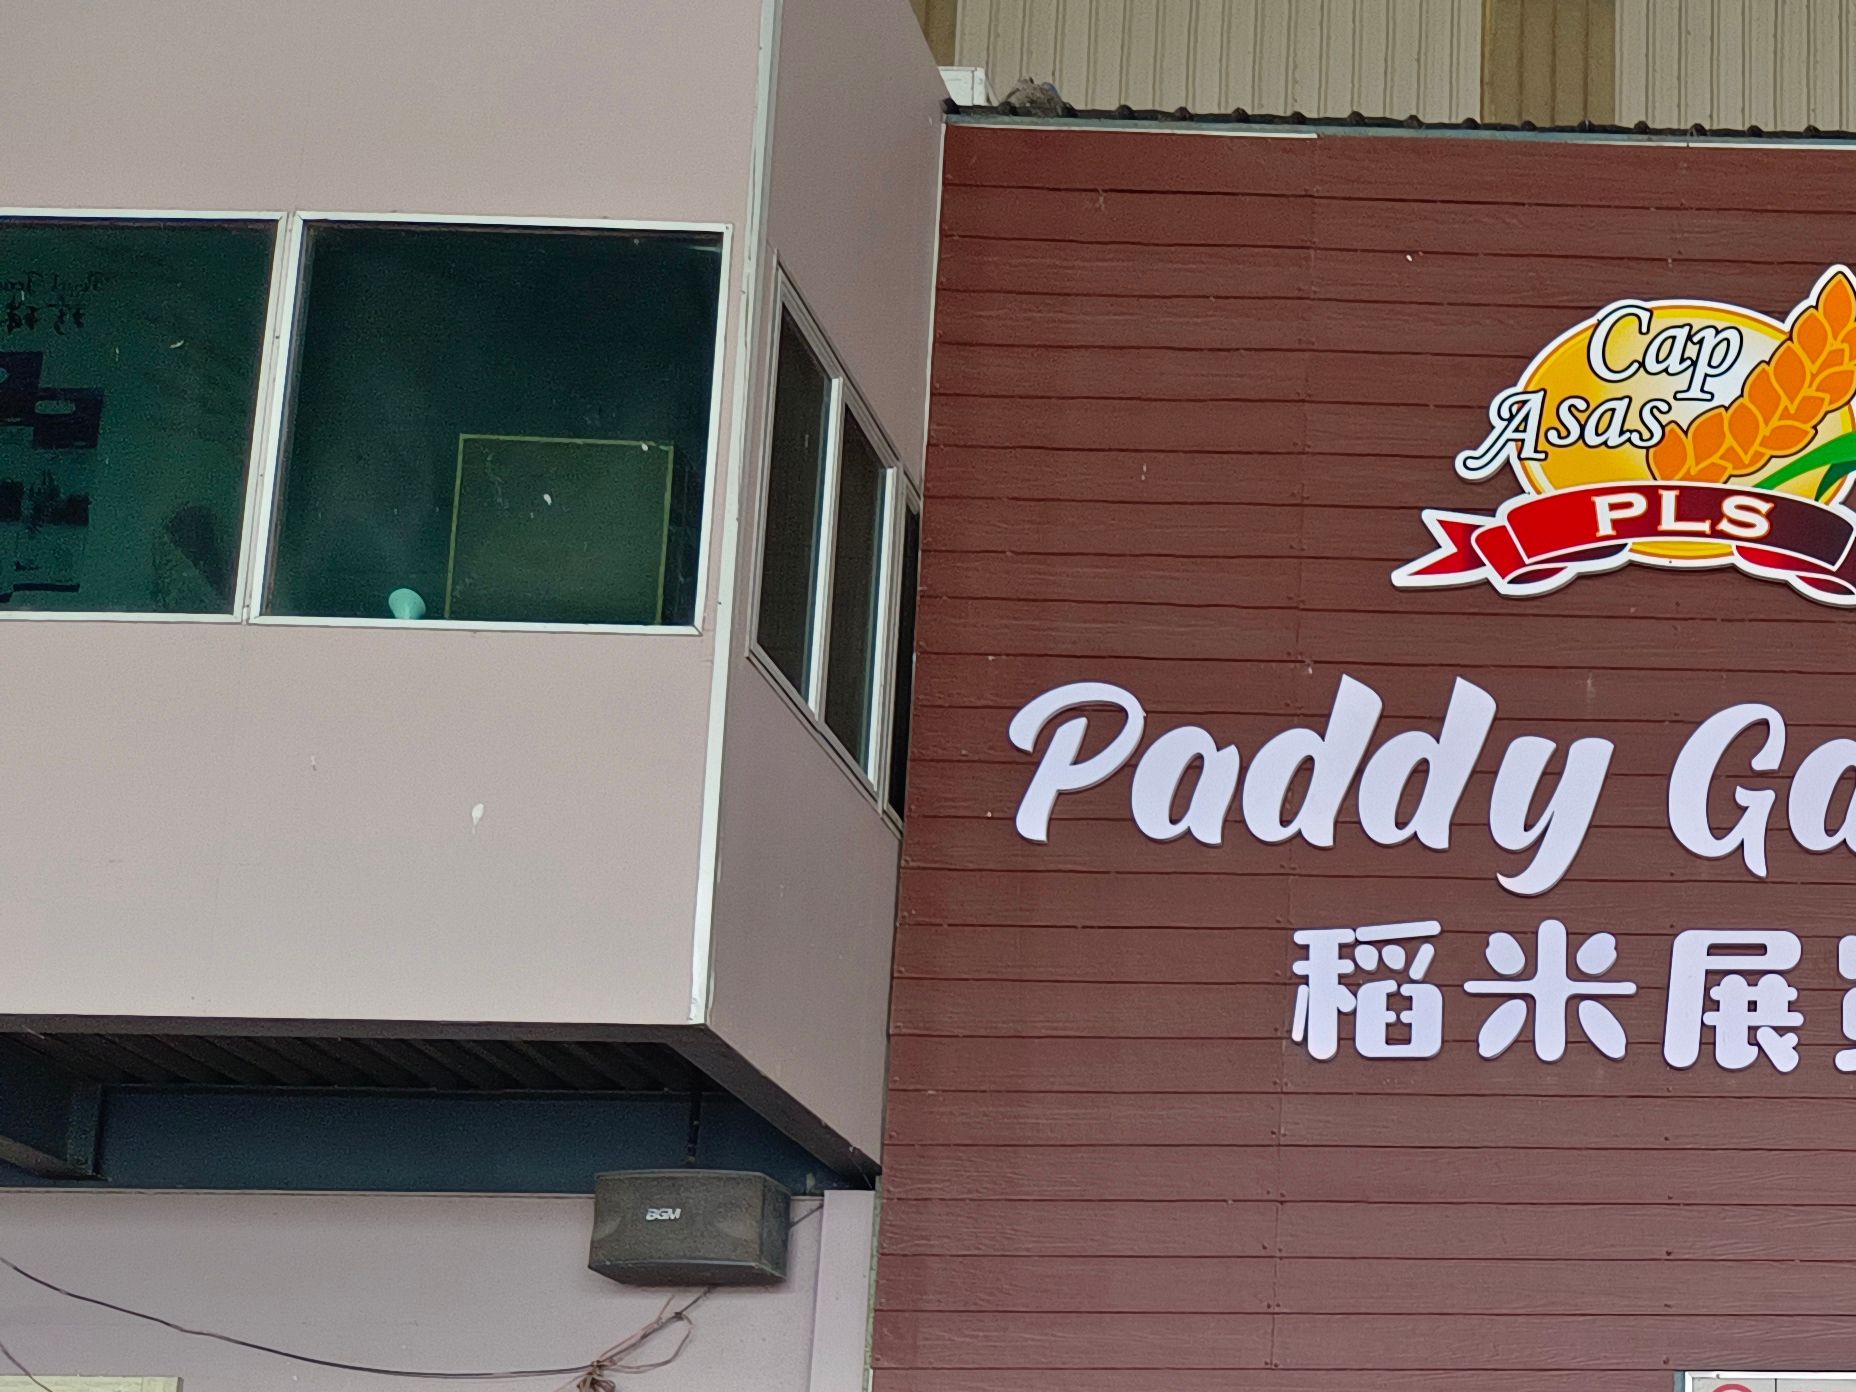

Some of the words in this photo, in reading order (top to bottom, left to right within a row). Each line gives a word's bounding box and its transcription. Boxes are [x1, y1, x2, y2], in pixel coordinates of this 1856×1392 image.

[1587, 305, 1743, 399] Cap
[1462, 389, 1671, 471] Asas
[1595, 489, 1774, 538] PLS
[1009, 674, 1614, 897] Paddy
